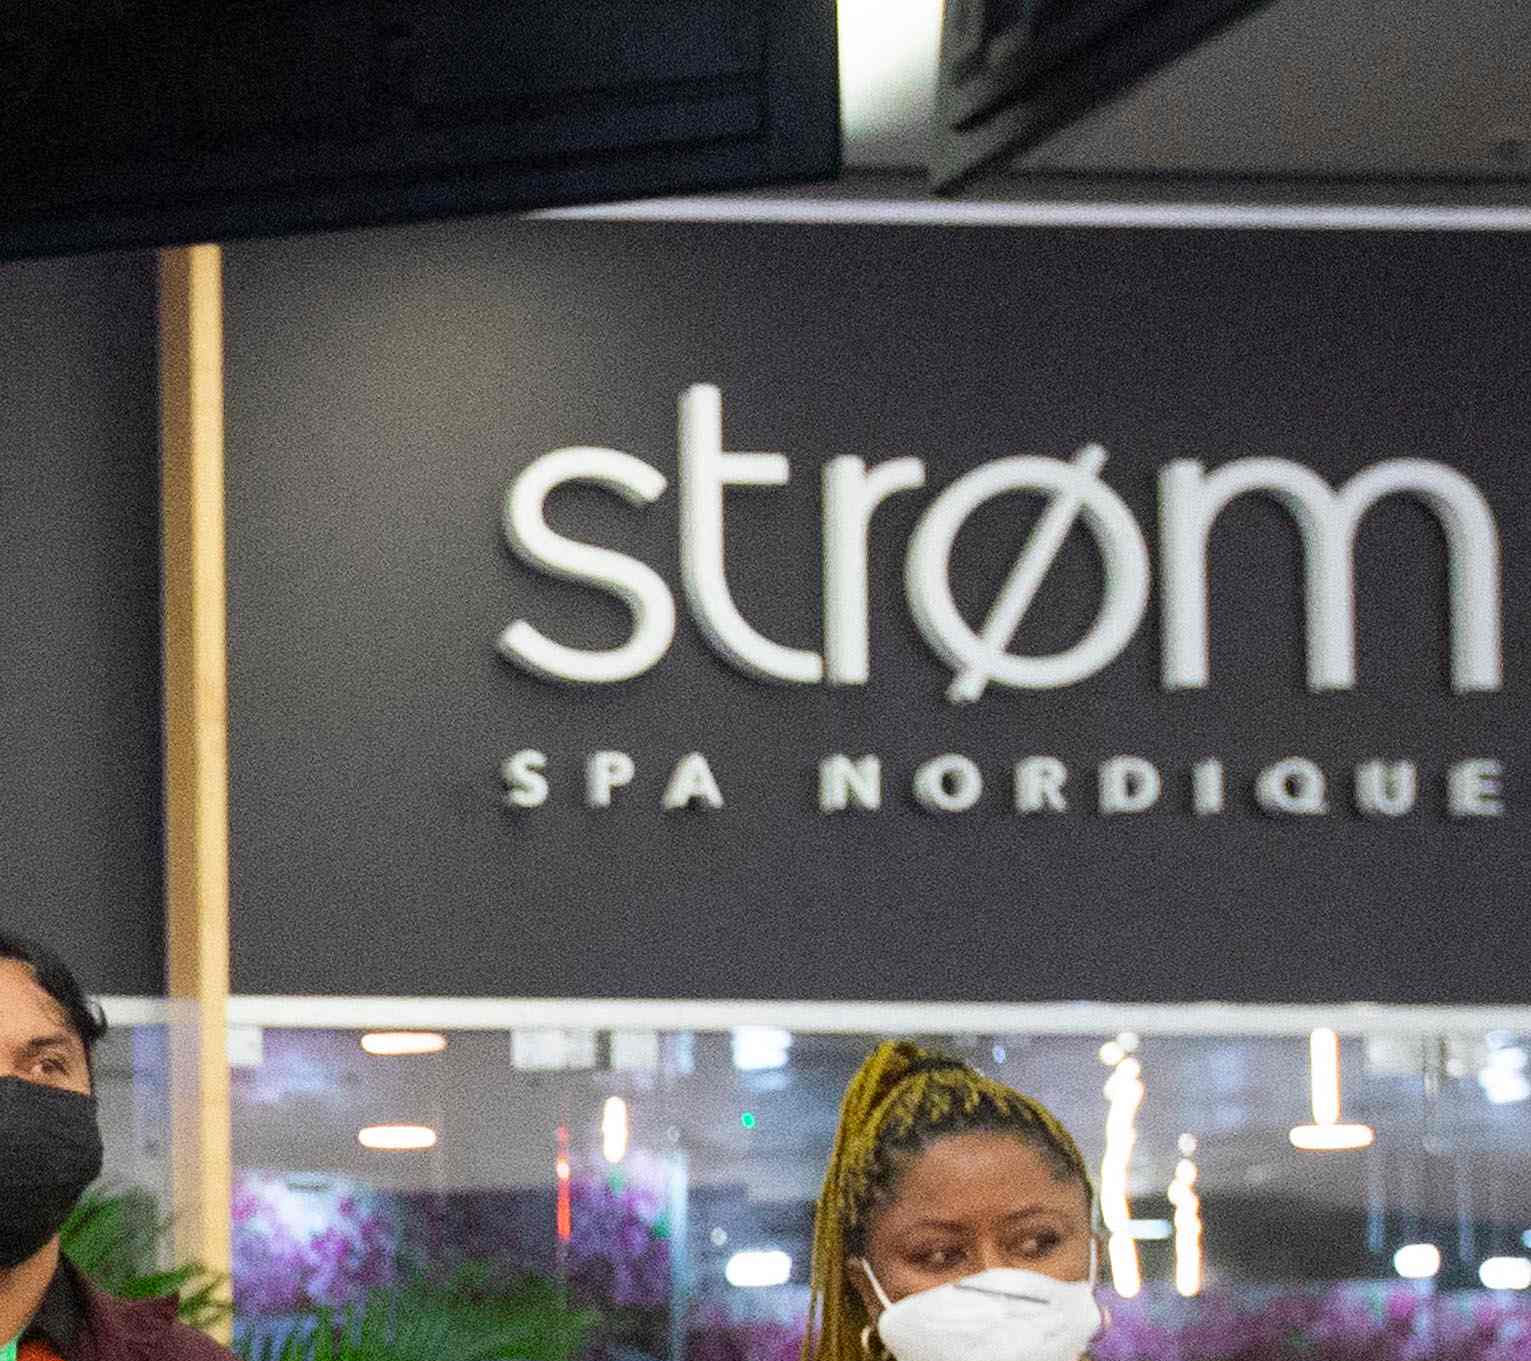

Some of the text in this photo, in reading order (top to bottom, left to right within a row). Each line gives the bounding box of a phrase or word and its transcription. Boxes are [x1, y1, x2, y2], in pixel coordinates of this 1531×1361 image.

[497, 383, 1503, 703] strøm
[501, 748, 1507, 818] SPA NORDIQUE
